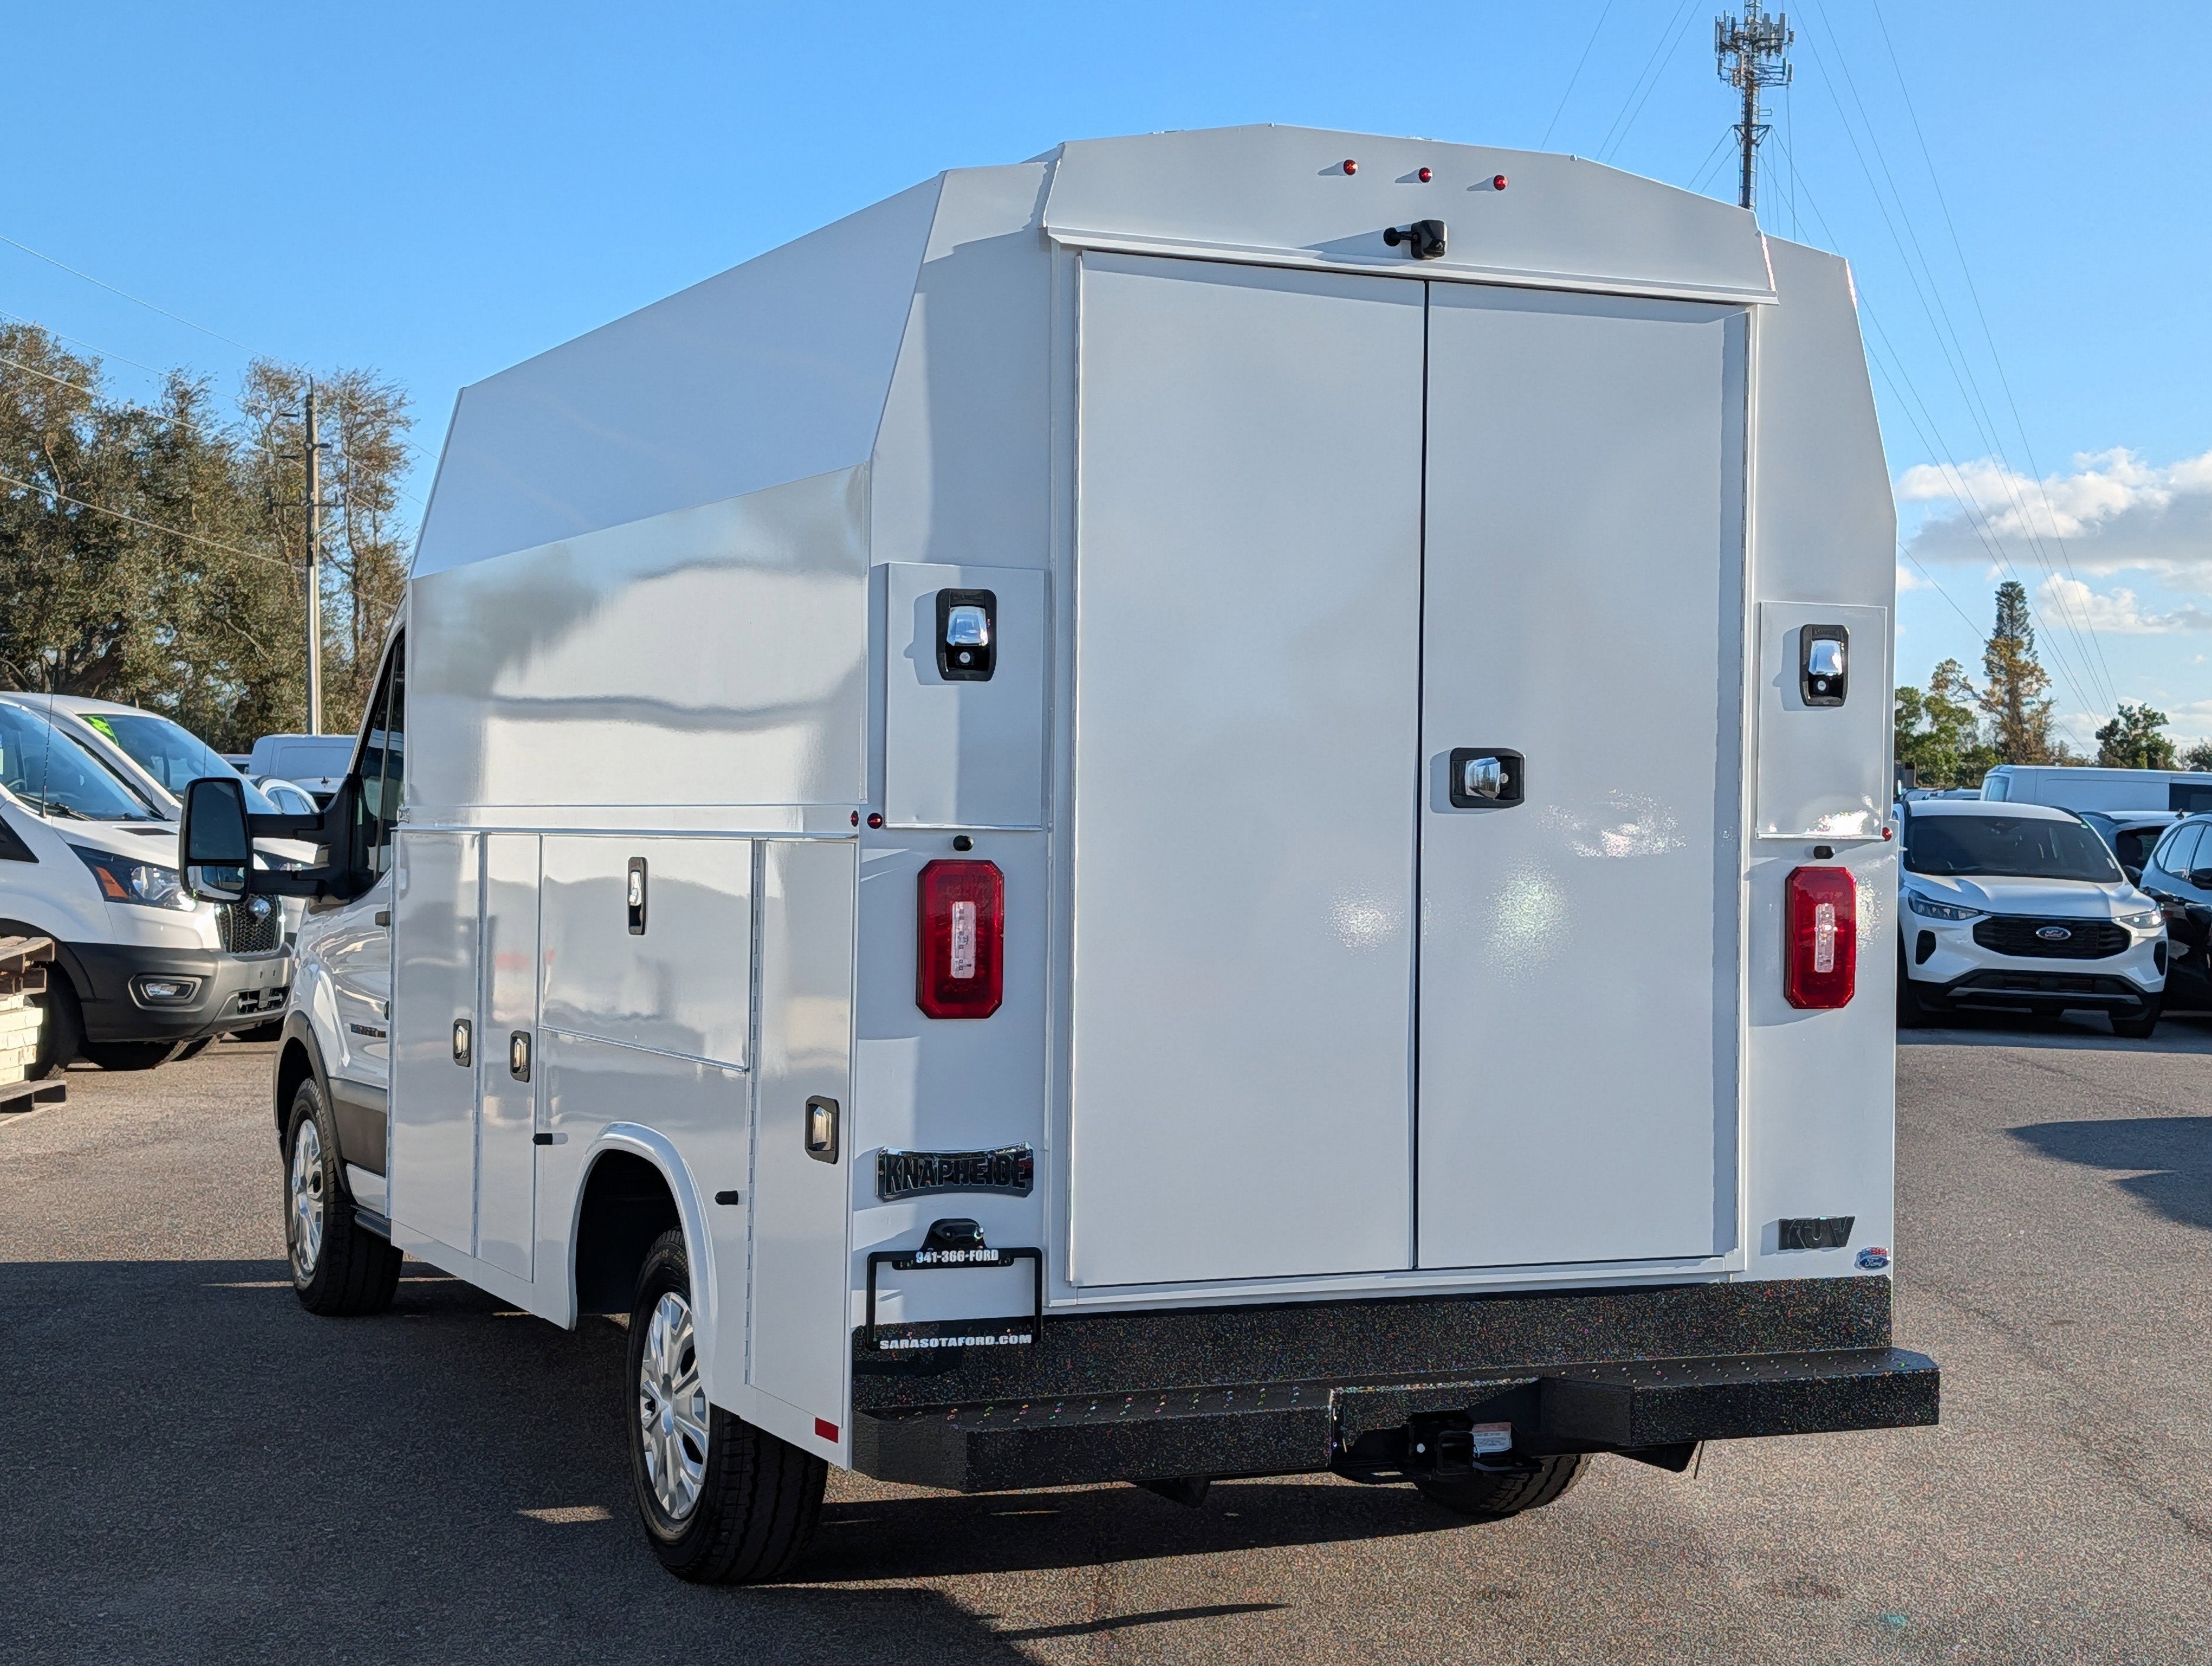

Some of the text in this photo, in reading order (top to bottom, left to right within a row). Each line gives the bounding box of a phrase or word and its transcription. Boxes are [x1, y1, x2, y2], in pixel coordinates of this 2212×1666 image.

[884, 1151, 1027, 1195] KNAPHEIDE
[1779, 1216, 1855, 1250] KUV
[879, 1334, 1032, 1349] SARASOTAFORD.COM
